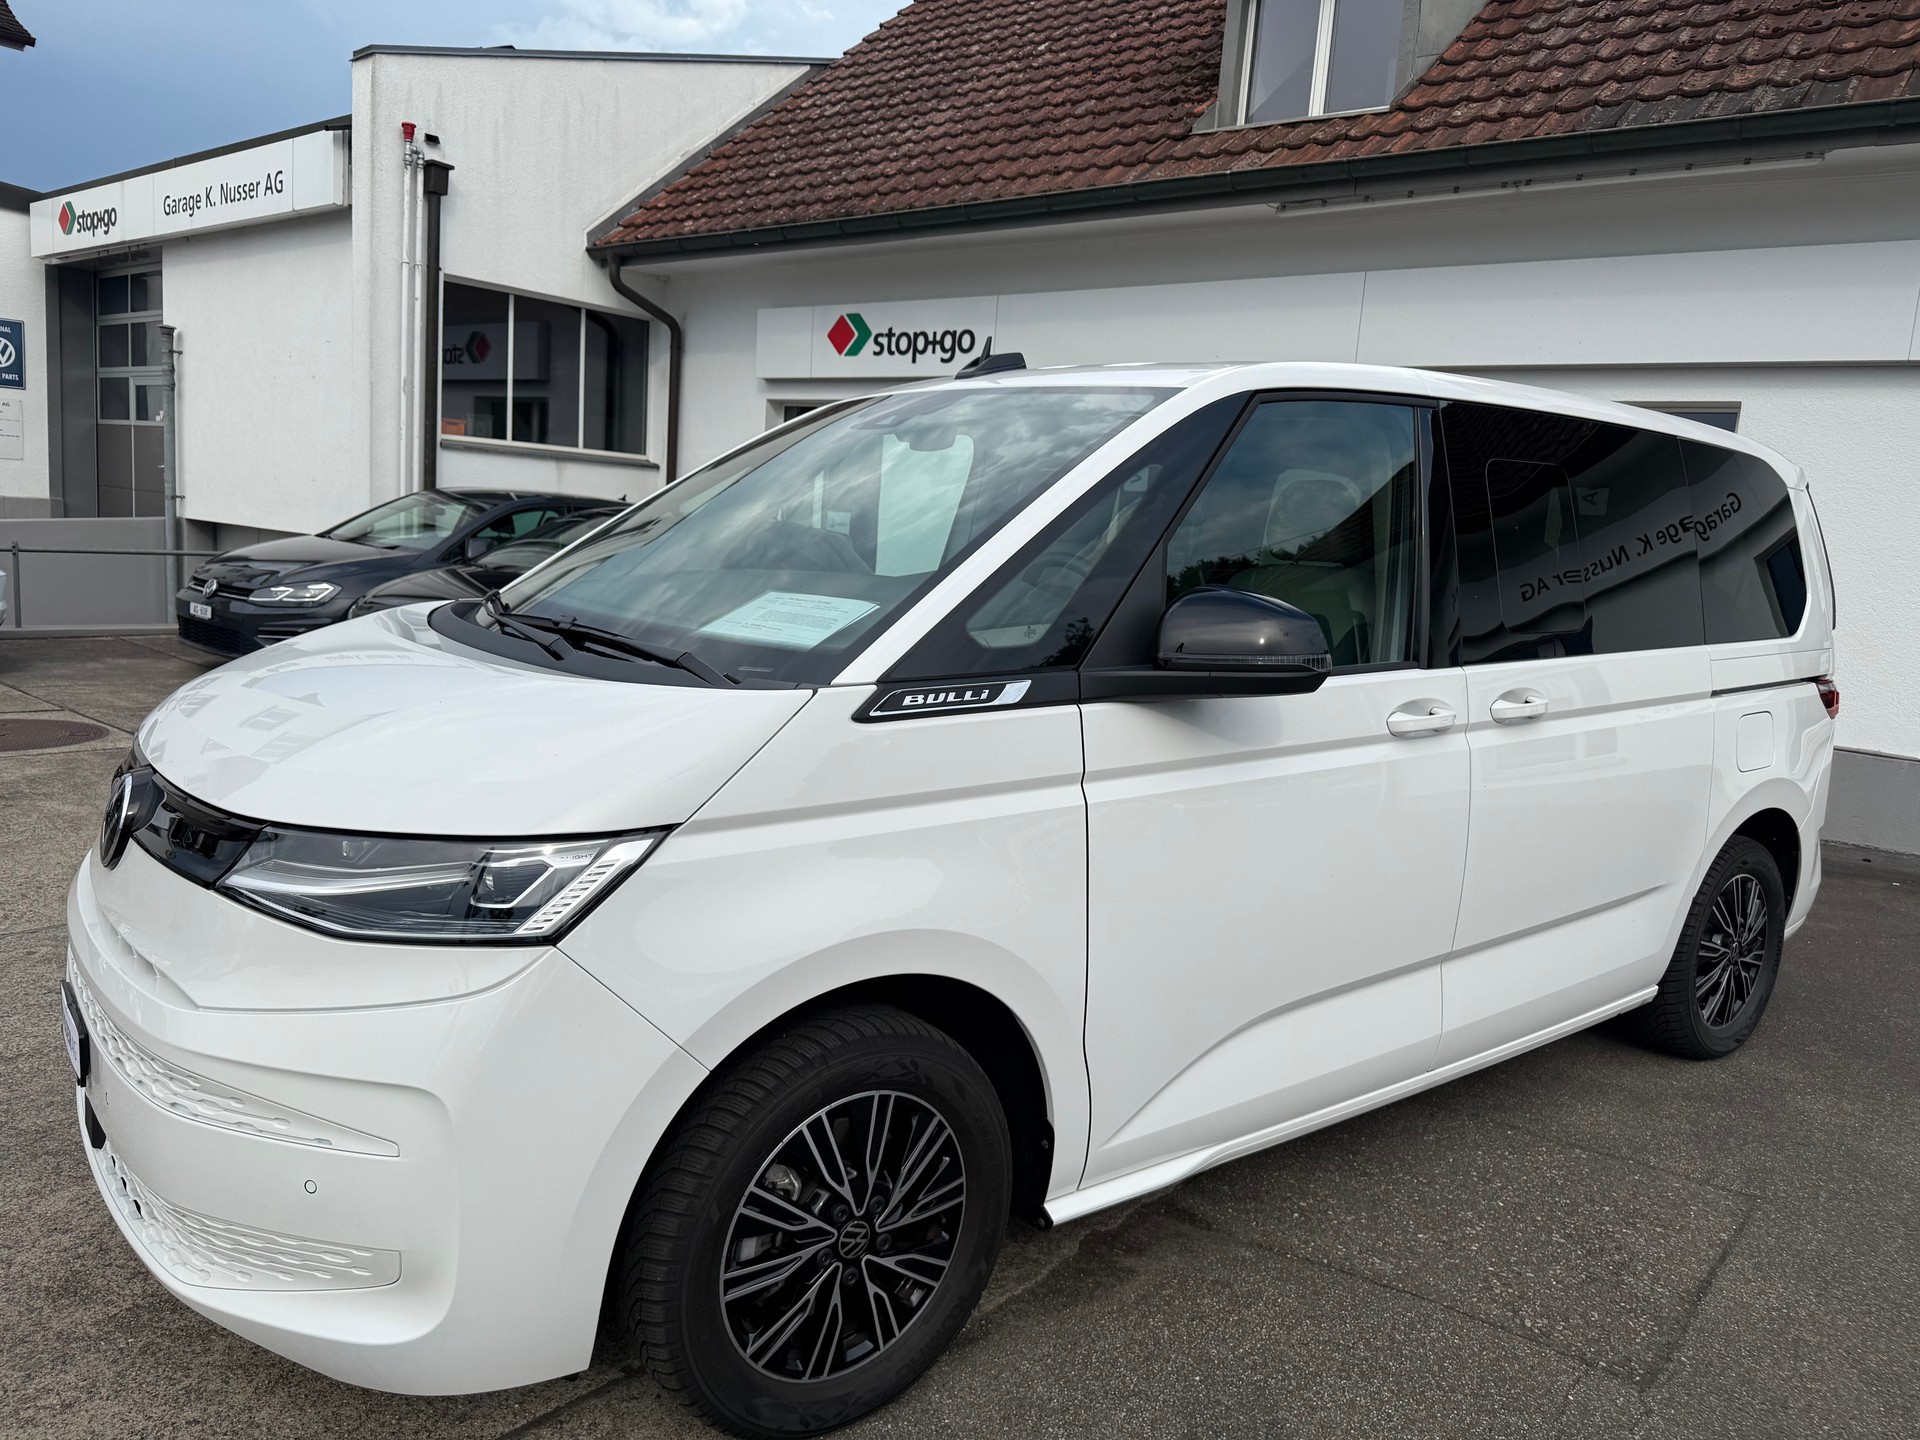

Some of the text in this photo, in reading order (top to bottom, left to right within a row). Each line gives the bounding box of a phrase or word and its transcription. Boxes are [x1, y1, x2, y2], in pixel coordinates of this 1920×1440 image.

[163, 170, 284, 217] Garage K. Nusser AG
[76, 206, 117, 238] stop+go
[872, 326, 976, 364] stop+go
[1, 372, 19, 381] PARTS
